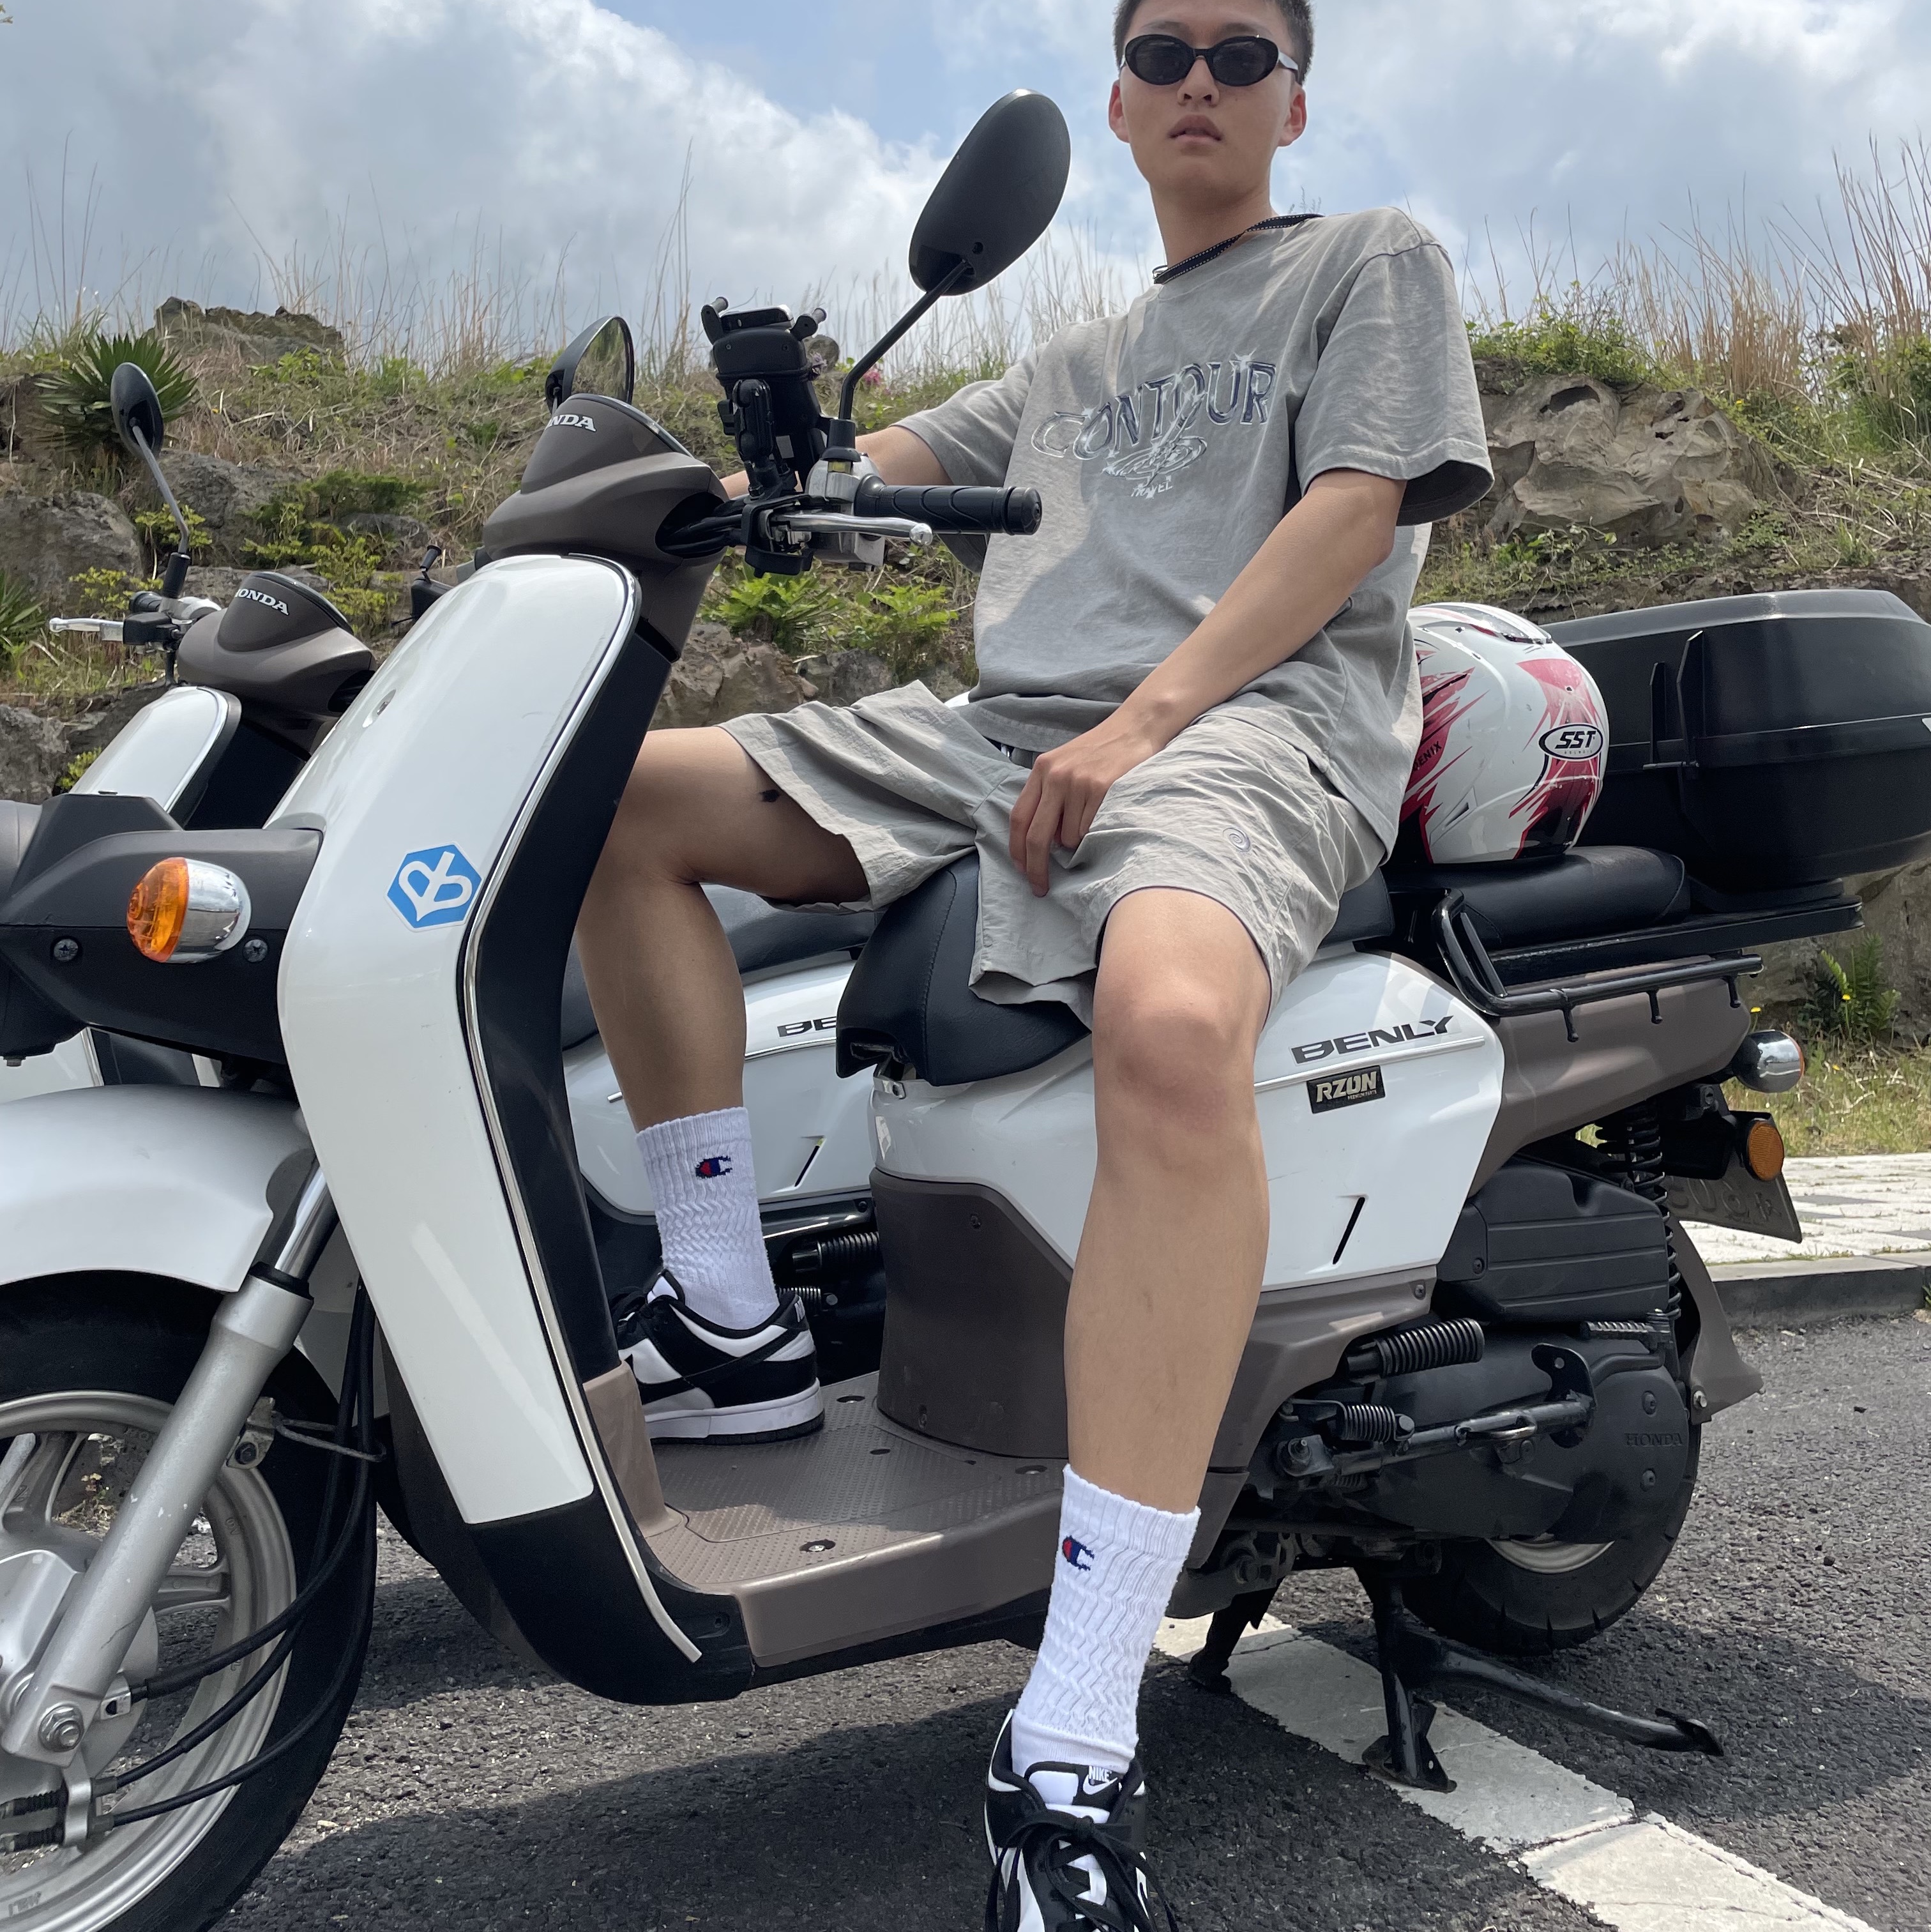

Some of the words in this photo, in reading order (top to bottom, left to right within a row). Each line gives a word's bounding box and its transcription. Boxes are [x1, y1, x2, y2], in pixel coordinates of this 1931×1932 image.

[1031, 361, 1276, 460] CONTOUR
[545, 414, 596, 432] NDA
[1554, 730, 1596, 749] SST
[1291, 1015, 1454, 1064] BENLY
[1624, 1433, 1683, 1447] HONDA
[1089, 1765, 1110, 1782] NIKE
